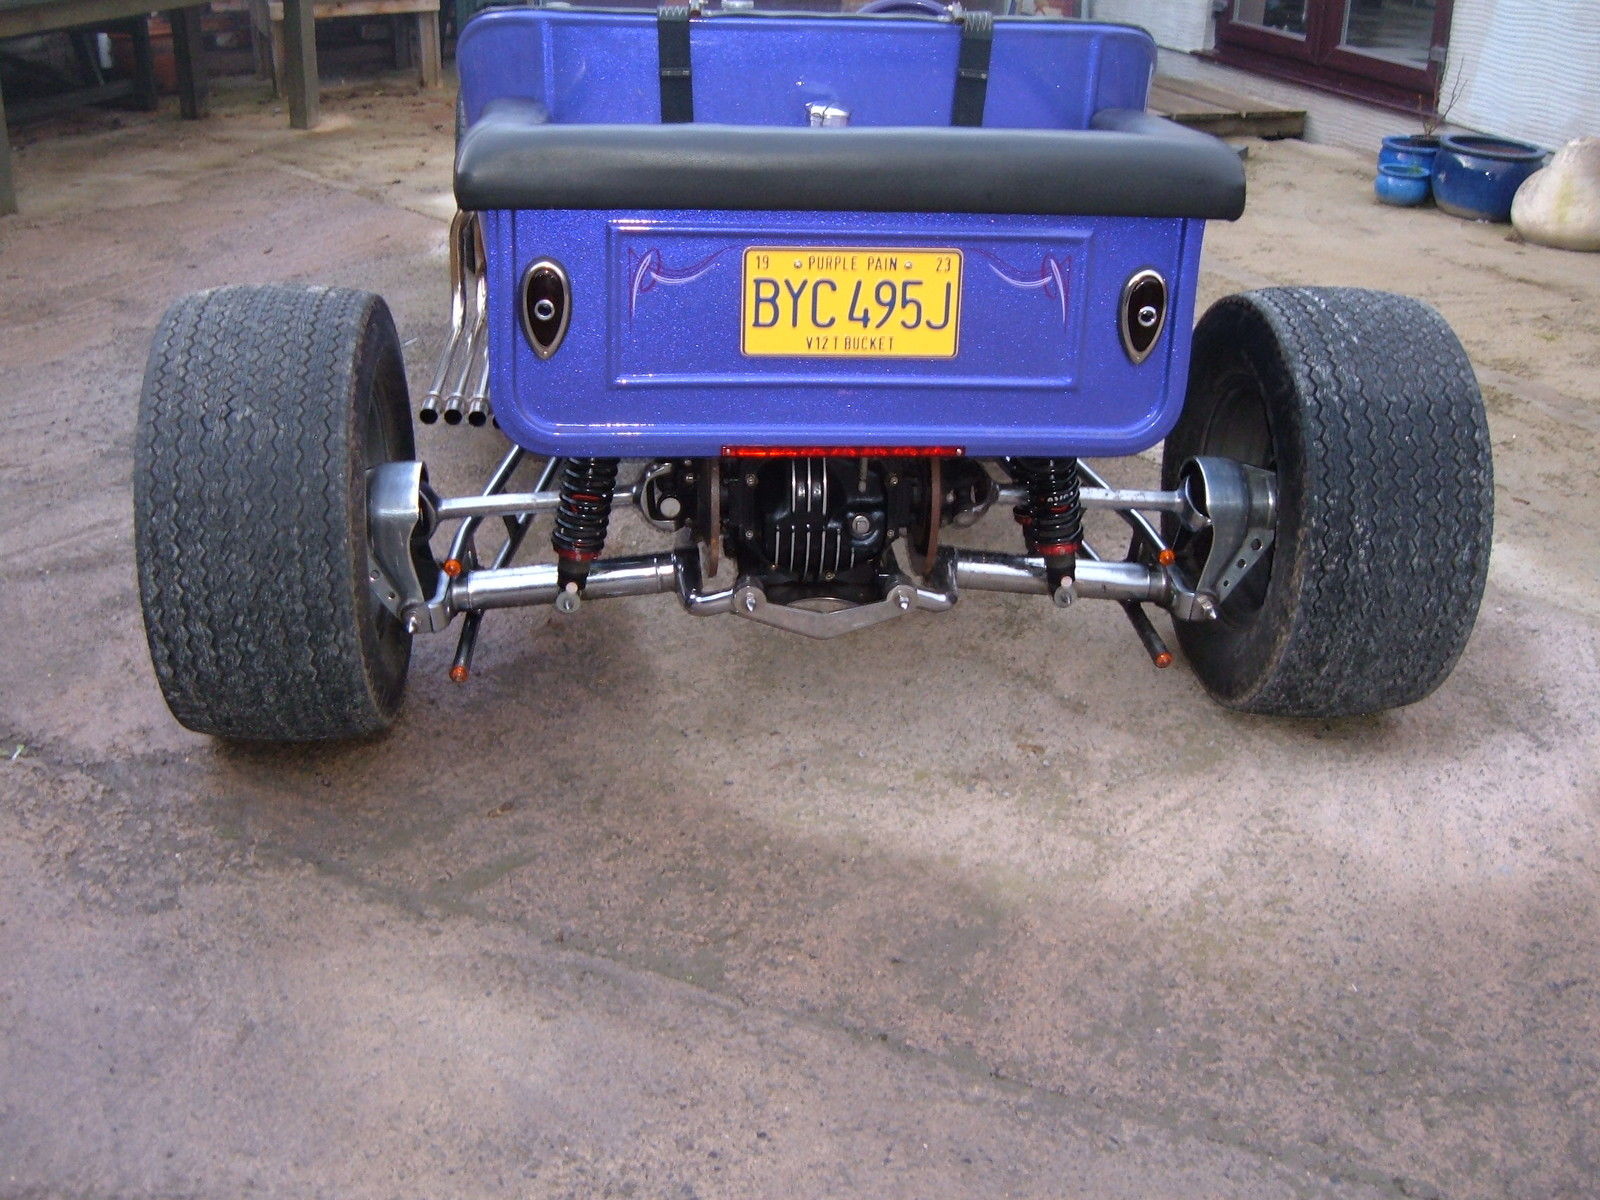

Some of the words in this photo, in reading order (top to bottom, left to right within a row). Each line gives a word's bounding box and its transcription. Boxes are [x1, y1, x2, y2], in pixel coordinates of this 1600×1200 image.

[756, 255, 769, 270] 19
[808, 256, 857, 271] PURPLE
[867, 257, 898, 271] PAIN
[936, 257, 951, 272] 23
[752, 278, 837, 328] BYC
[848, 279, 951, 330] 495J
[844, 337, 894, 351] BUCKET
